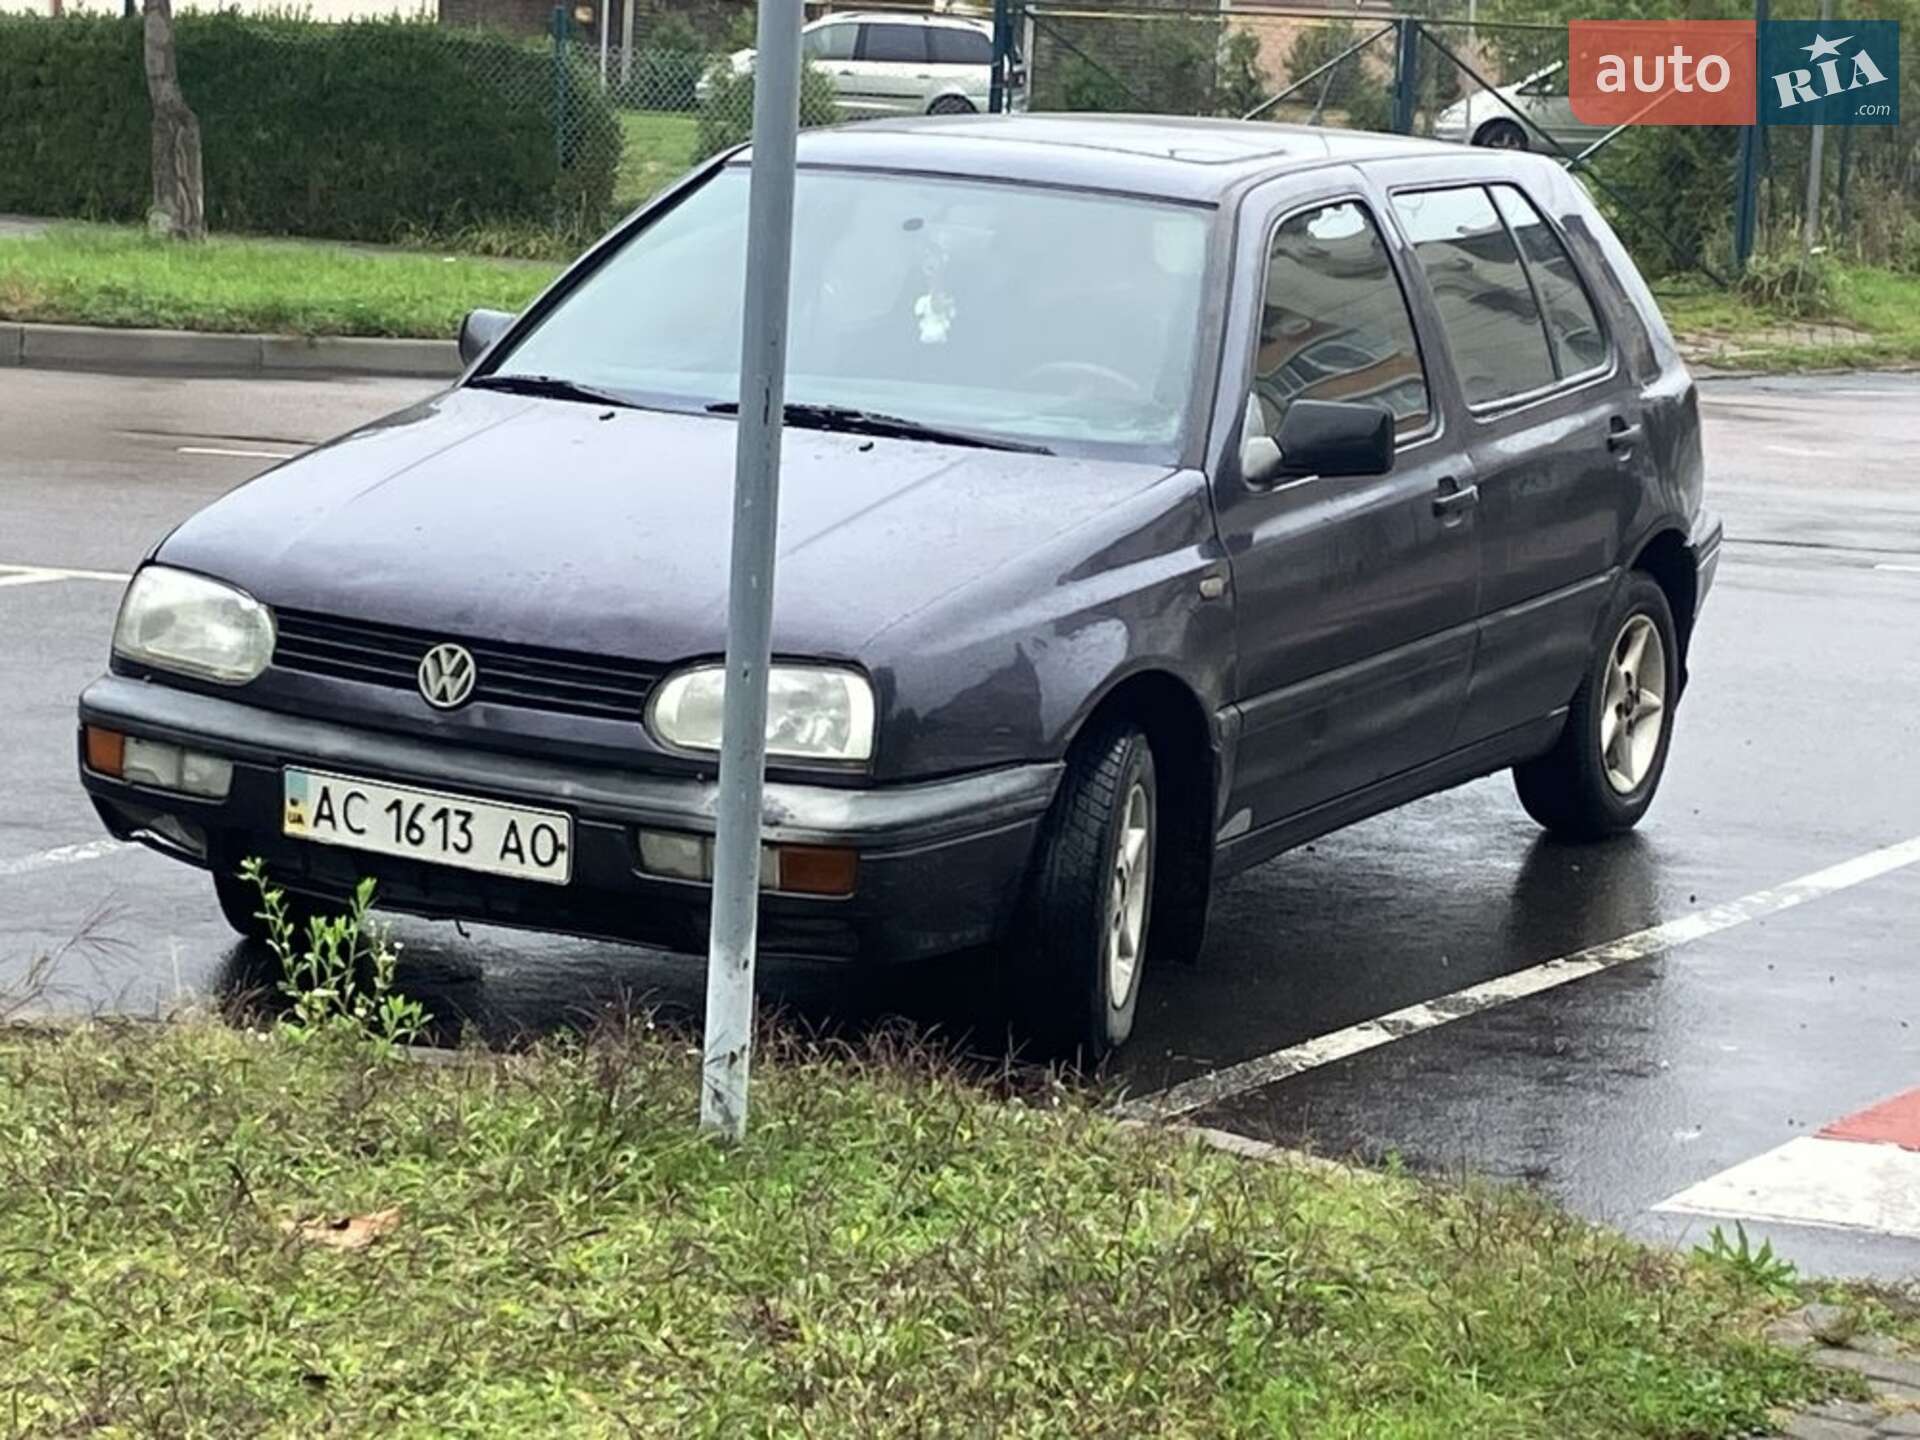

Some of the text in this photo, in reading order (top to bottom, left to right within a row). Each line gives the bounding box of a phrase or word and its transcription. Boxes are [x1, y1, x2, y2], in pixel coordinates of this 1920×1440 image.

[419, 644, 475, 707] VW
[287, 812, 305, 826] UA
[313, 786, 560, 867] AC 1613 AO
